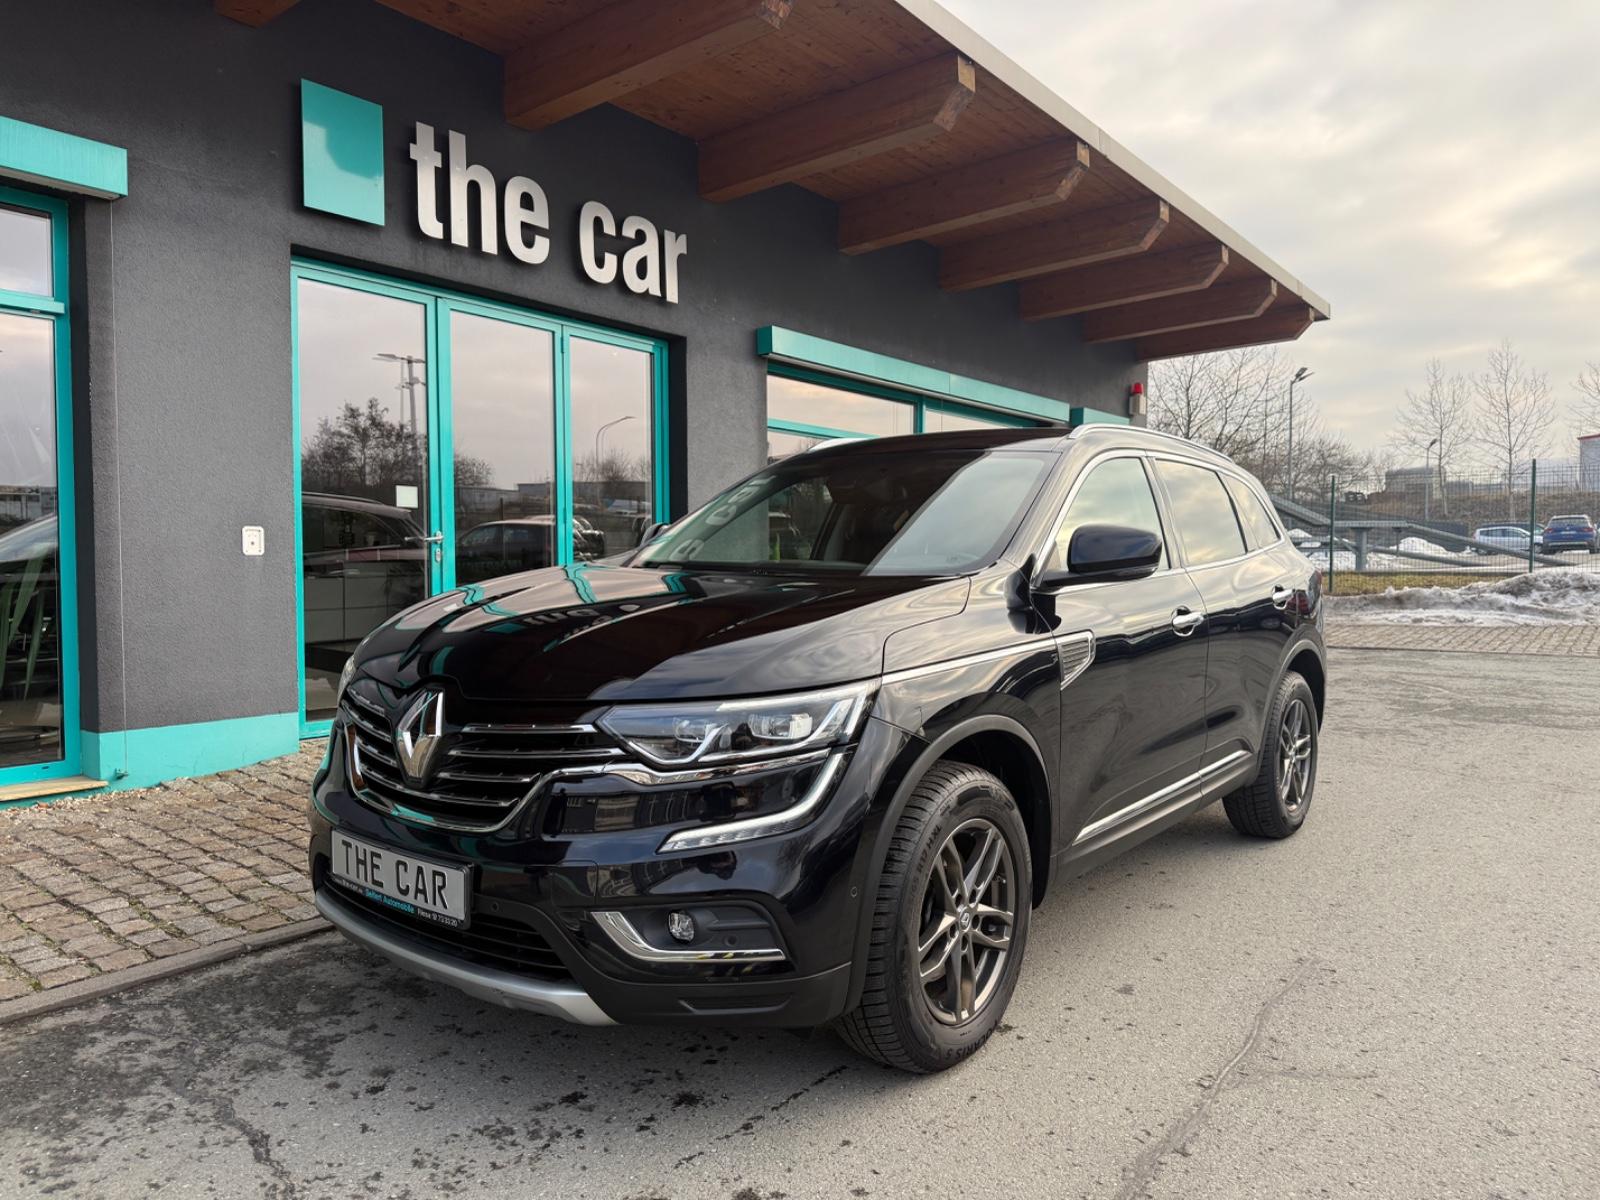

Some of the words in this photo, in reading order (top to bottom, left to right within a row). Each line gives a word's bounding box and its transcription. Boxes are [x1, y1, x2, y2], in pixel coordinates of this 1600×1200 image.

[410, 121, 551, 265] the
[579, 200, 688, 305] car
[342, 839, 384, 888] THE
[396, 859, 448, 910] CAR
[383, 895, 415, 914] Automobile
